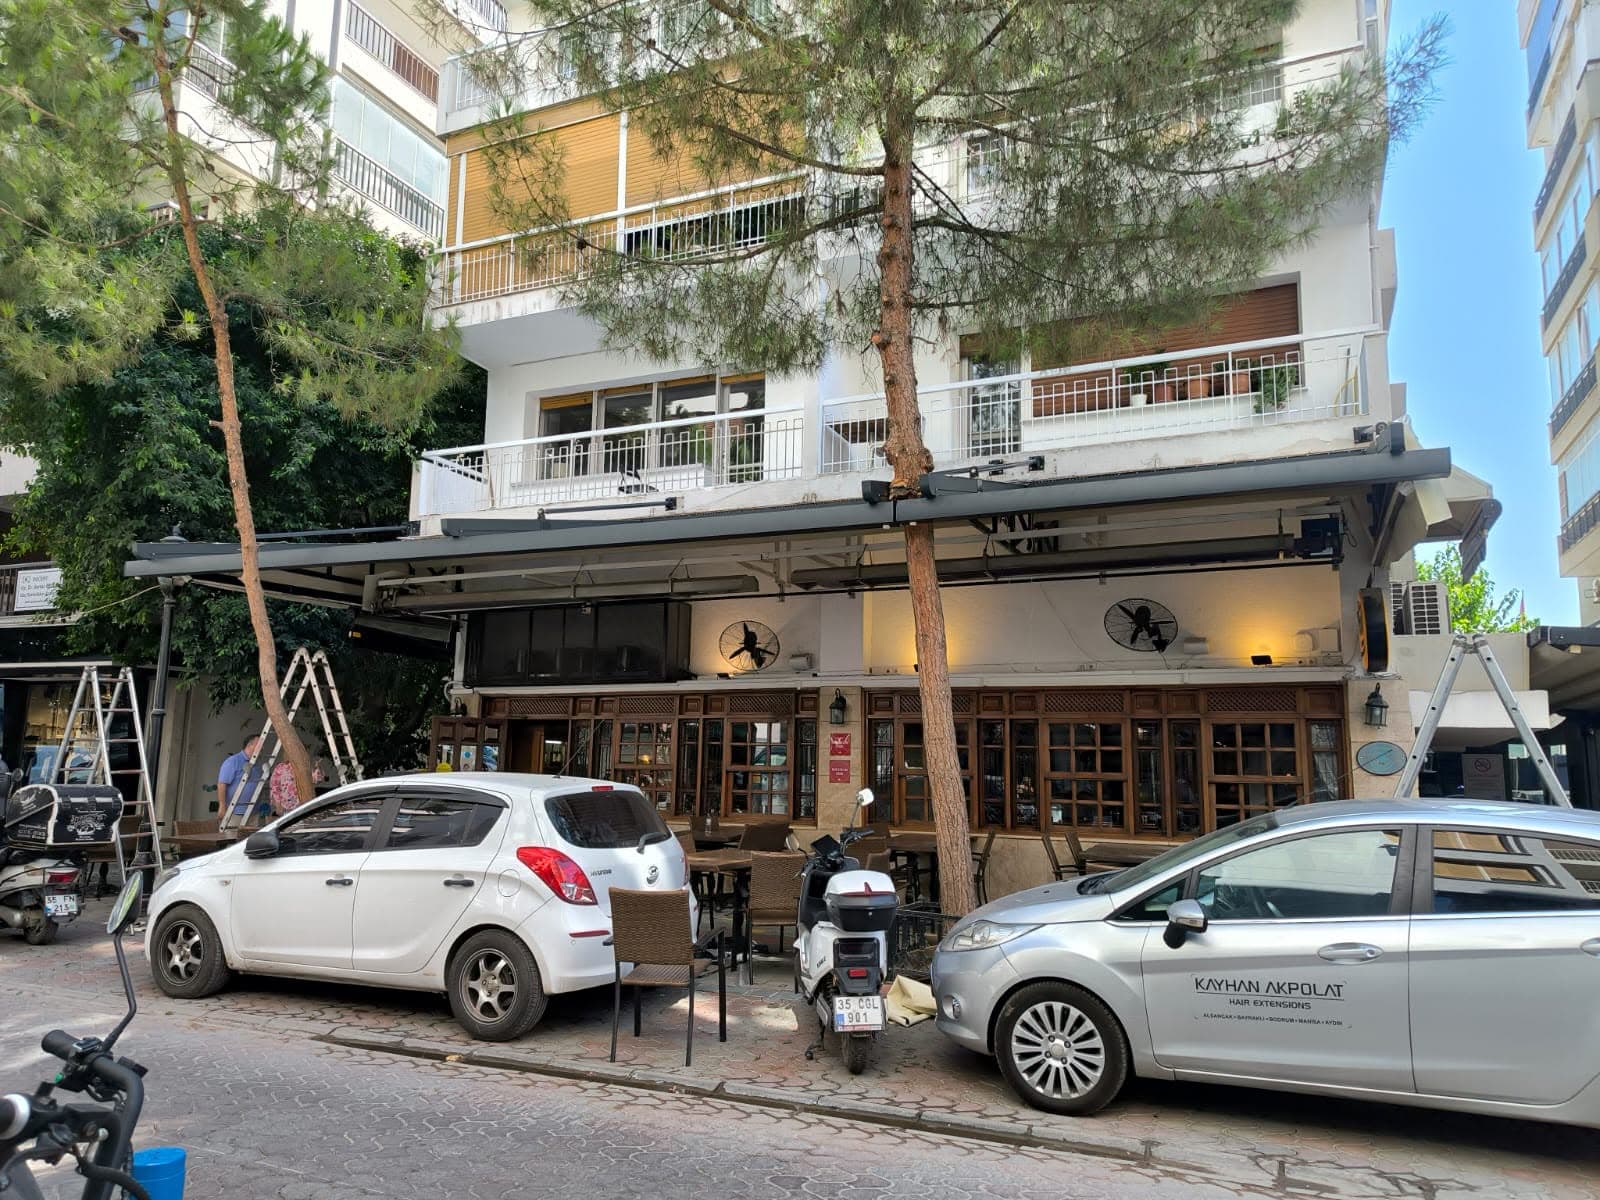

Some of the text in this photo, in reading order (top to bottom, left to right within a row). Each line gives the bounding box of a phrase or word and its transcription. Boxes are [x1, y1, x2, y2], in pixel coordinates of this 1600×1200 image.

[1195, 977, 1344, 997] KAYHAN AKPOLAT
[838, 997, 879, 1010] 35 CGL
[1229, 998, 1312, 1010] HAIR EXTENSIONS
[847, 1011, 868, 1023] 901
